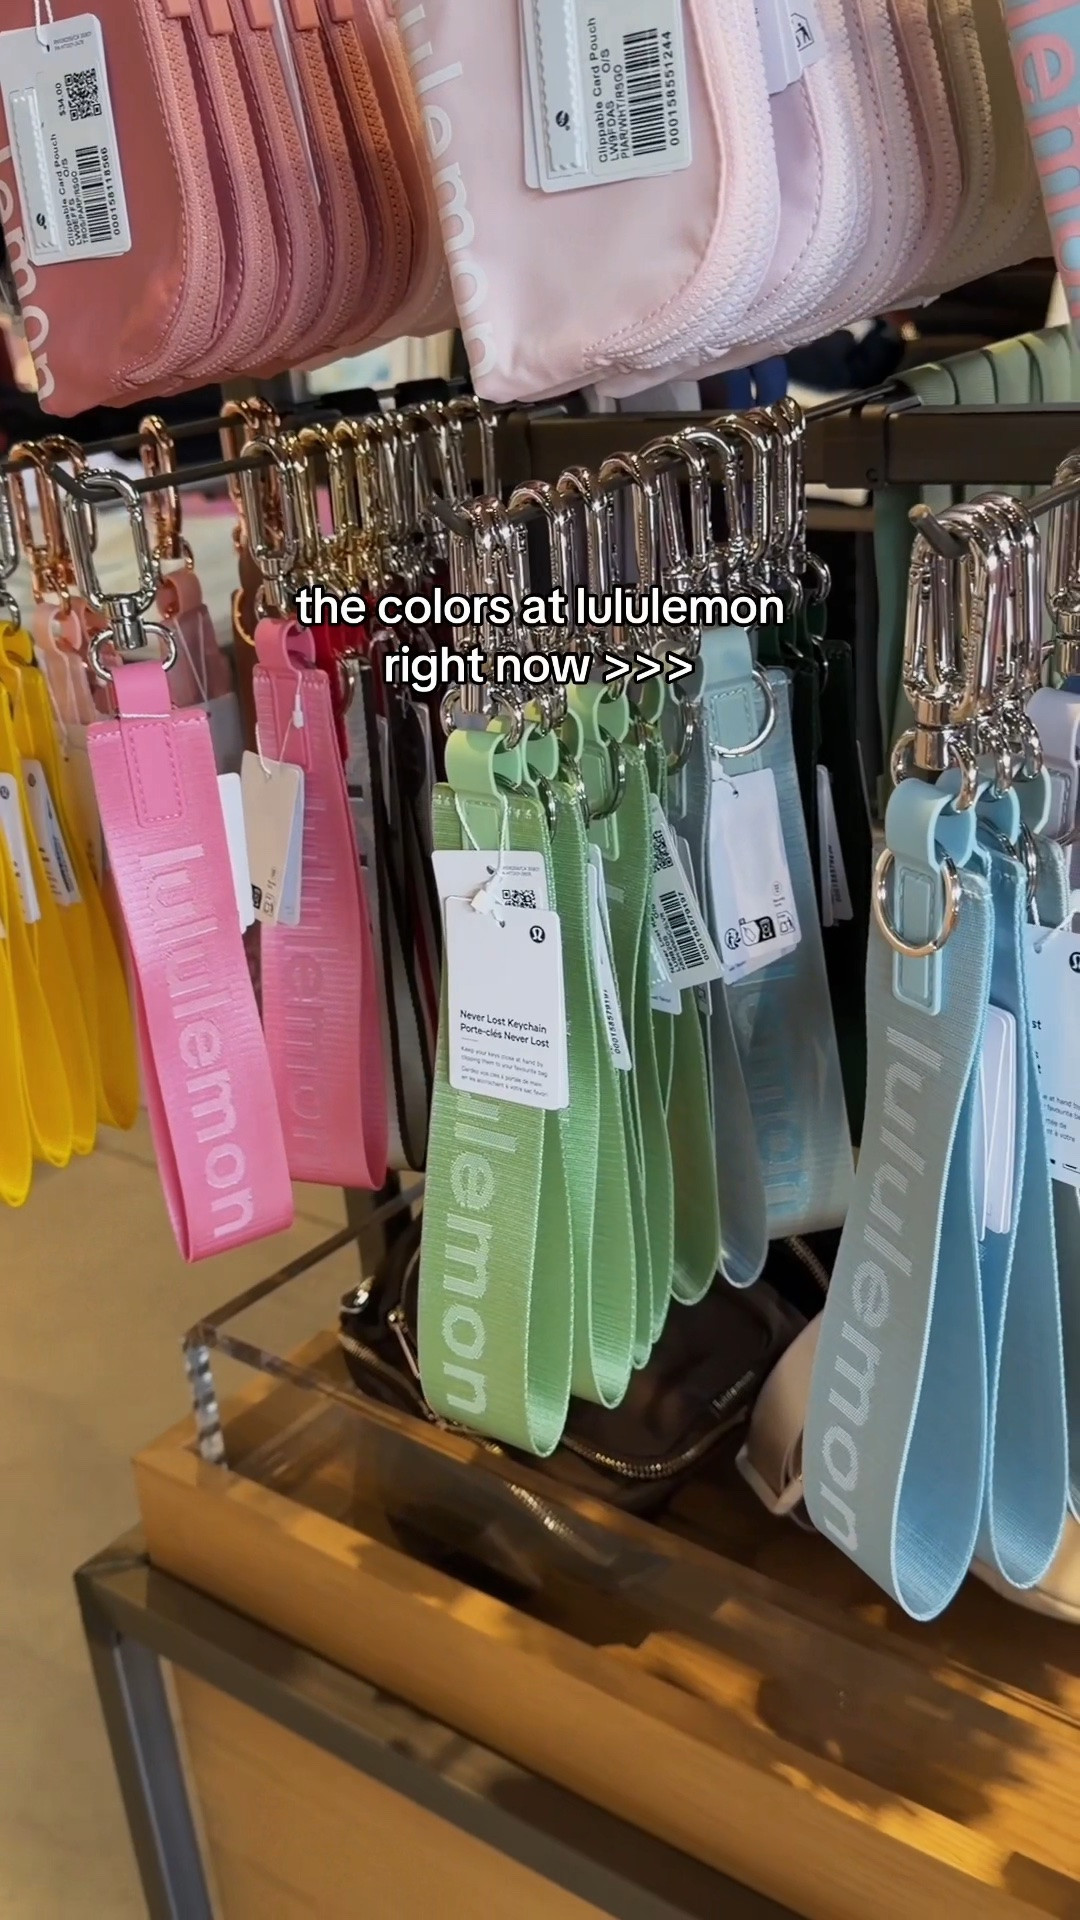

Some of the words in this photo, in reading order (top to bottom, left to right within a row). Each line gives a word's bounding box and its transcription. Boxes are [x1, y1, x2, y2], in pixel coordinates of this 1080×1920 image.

[587, 17, 598, 61] Pouch
[601, 49, 611, 73] O/S
[591, 65, 602, 97] Card
[661, 31, 680, 146] 000158551244
[55, 82, 66, 116] $34.00
[595, 101, 608, 163] Clippable
[50, 134, 60, 168] Pouch
[61, 158, 69, 177] O/S
[56, 171, 66, 195] Card
[62, 198, 75, 246] Clippable
[460, 1009, 485, 1021] Never
[487, 1014, 506, 1026] Lost
[507, 1018, 547, 1034] Keychain
[460, 1022, 502, 1039] Porte-clés
[504, 1031, 529, 1044] Never
[530, 1036, 550, 1048] Lost
[139, 843, 254, 1238] lululemon
[819, 1025, 943, 1553] lululemon
